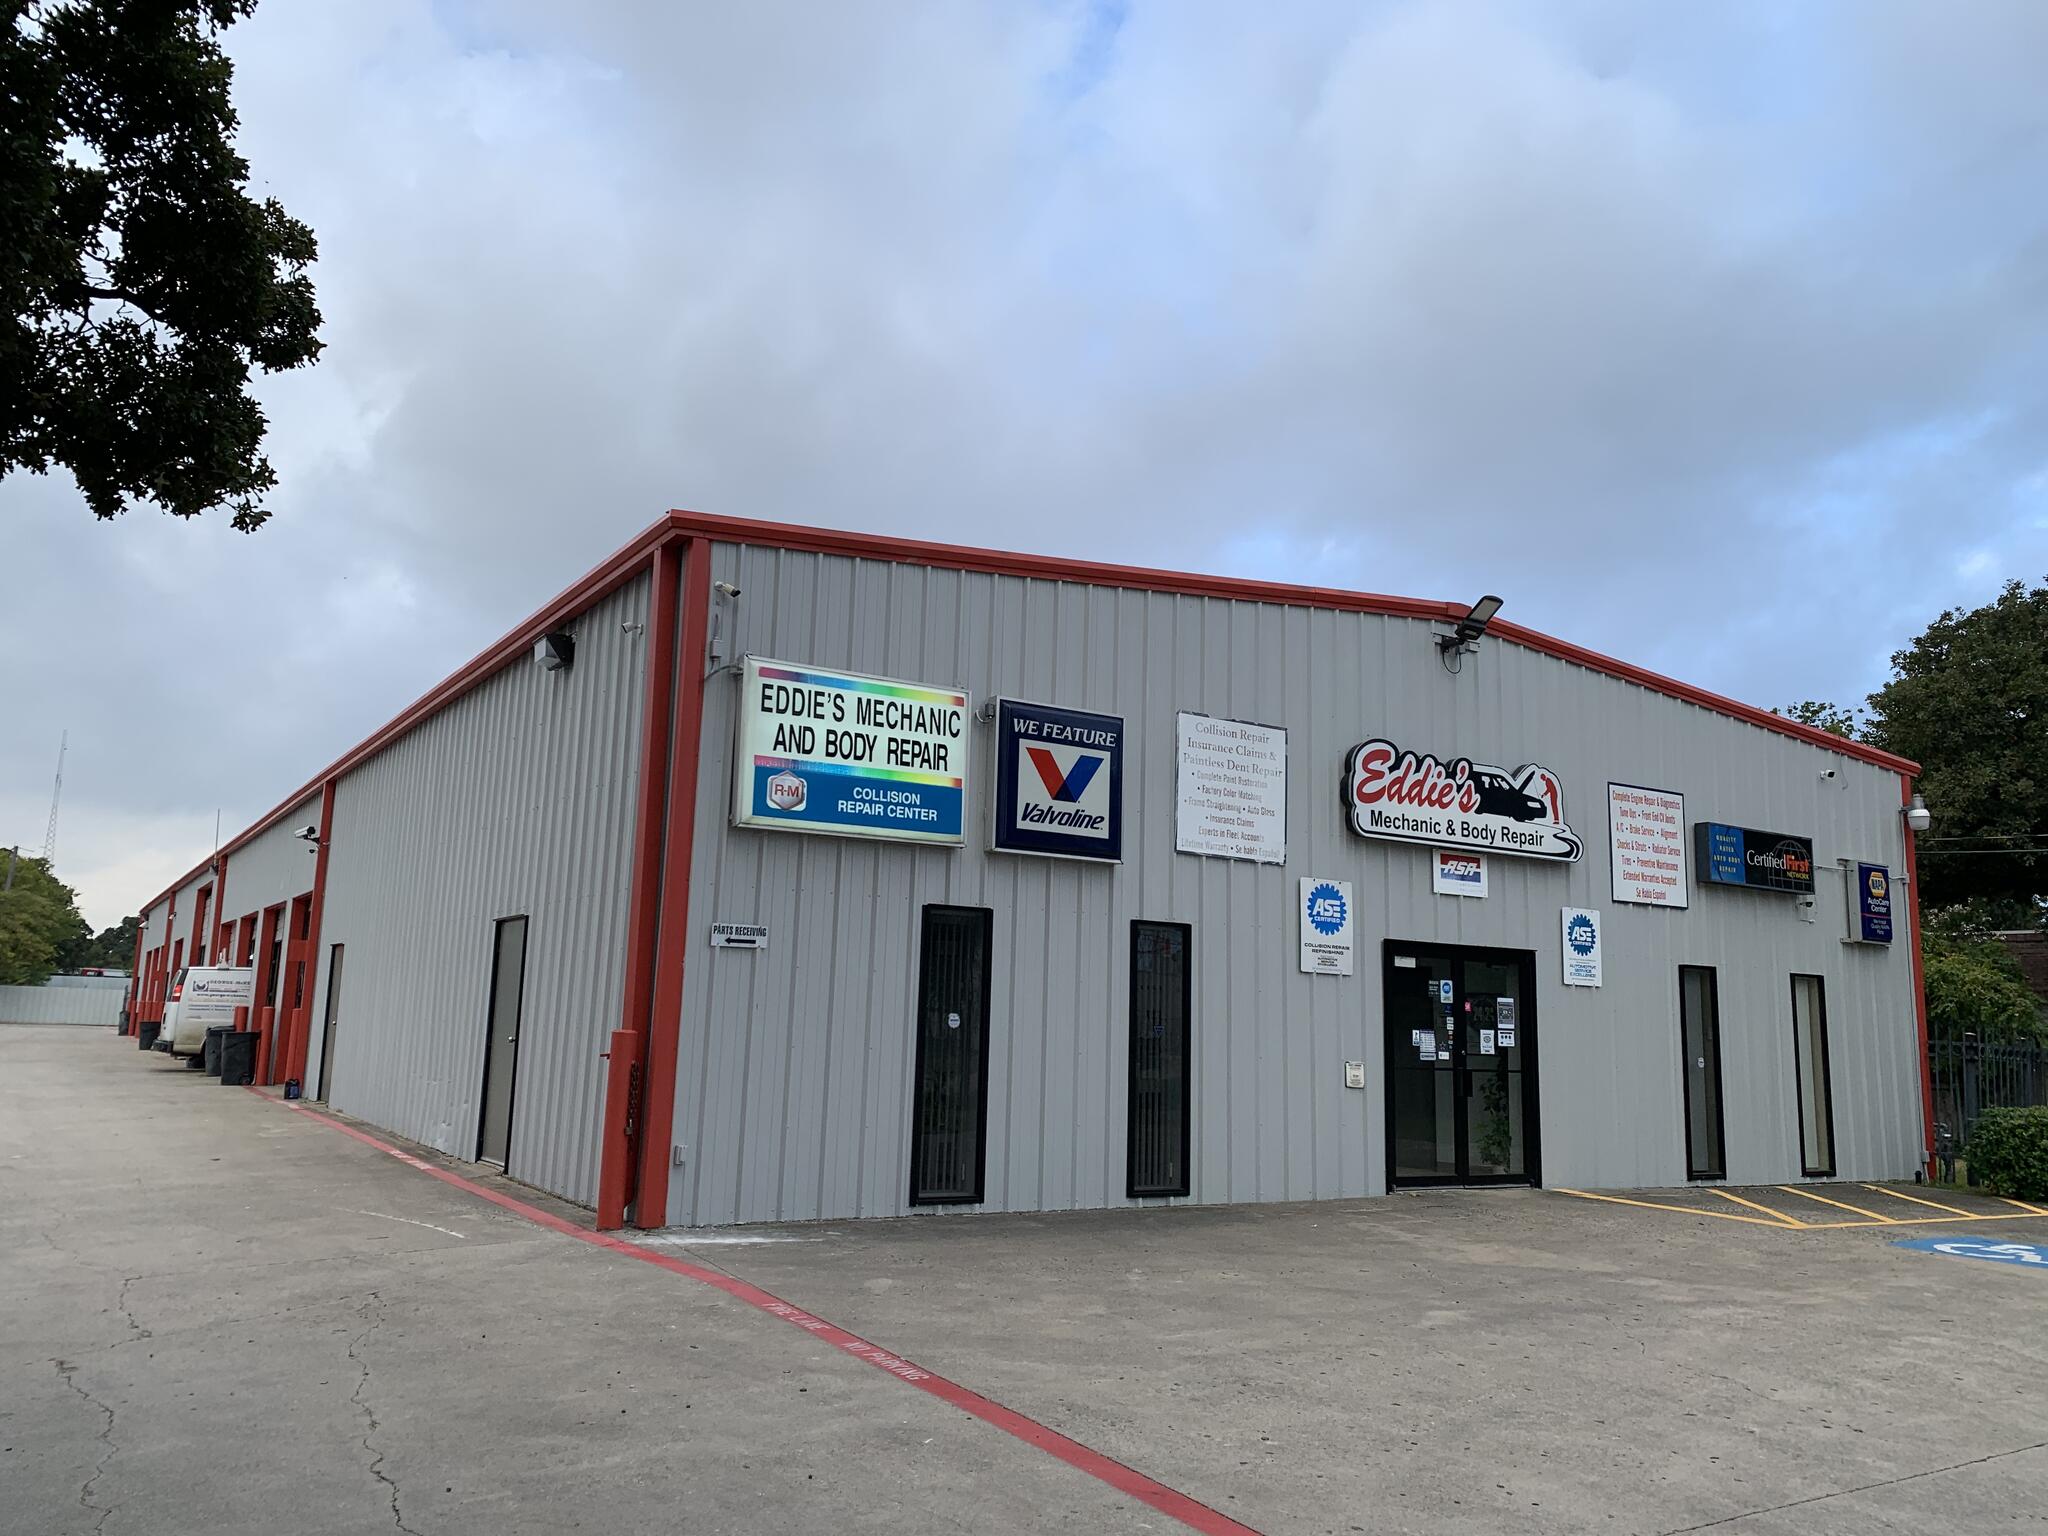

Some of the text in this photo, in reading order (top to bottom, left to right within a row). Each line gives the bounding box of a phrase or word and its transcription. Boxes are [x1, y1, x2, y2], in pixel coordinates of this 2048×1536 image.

[761, 683, 961, 738] EDDIE'S MECHANIC
[1013, 718, 1117, 747] WE FEATURE
[1195, 722, 1270, 745] Collision Repair
[772, 723, 815, 755] AND
[825, 728, 878, 762] BODY
[887, 737, 948, 772] REPAIR
[1188, 737, 1234, 753] Insurance
[1236, 745, 1267, 760] Claims
[1183, 752, 1282, 778] Paintless Dent Repair
[1356, 748, 1480, 814] Eddie's
[853, 787, 920, 806] COLLISION
[838, 800, 938, 821] REPAIR CENTER
[1021, 802, 1105, 830] Valvoline
[1370, 810, 1544, 848] Mechanic & Body Repair
[1443, 860, 1477, 876] ASA
[1312, 898, 1341, 918] ASE
[713, 924, 767, 937] PARTS RECEIVING
[1572, 926, 1592, 941] ASE
